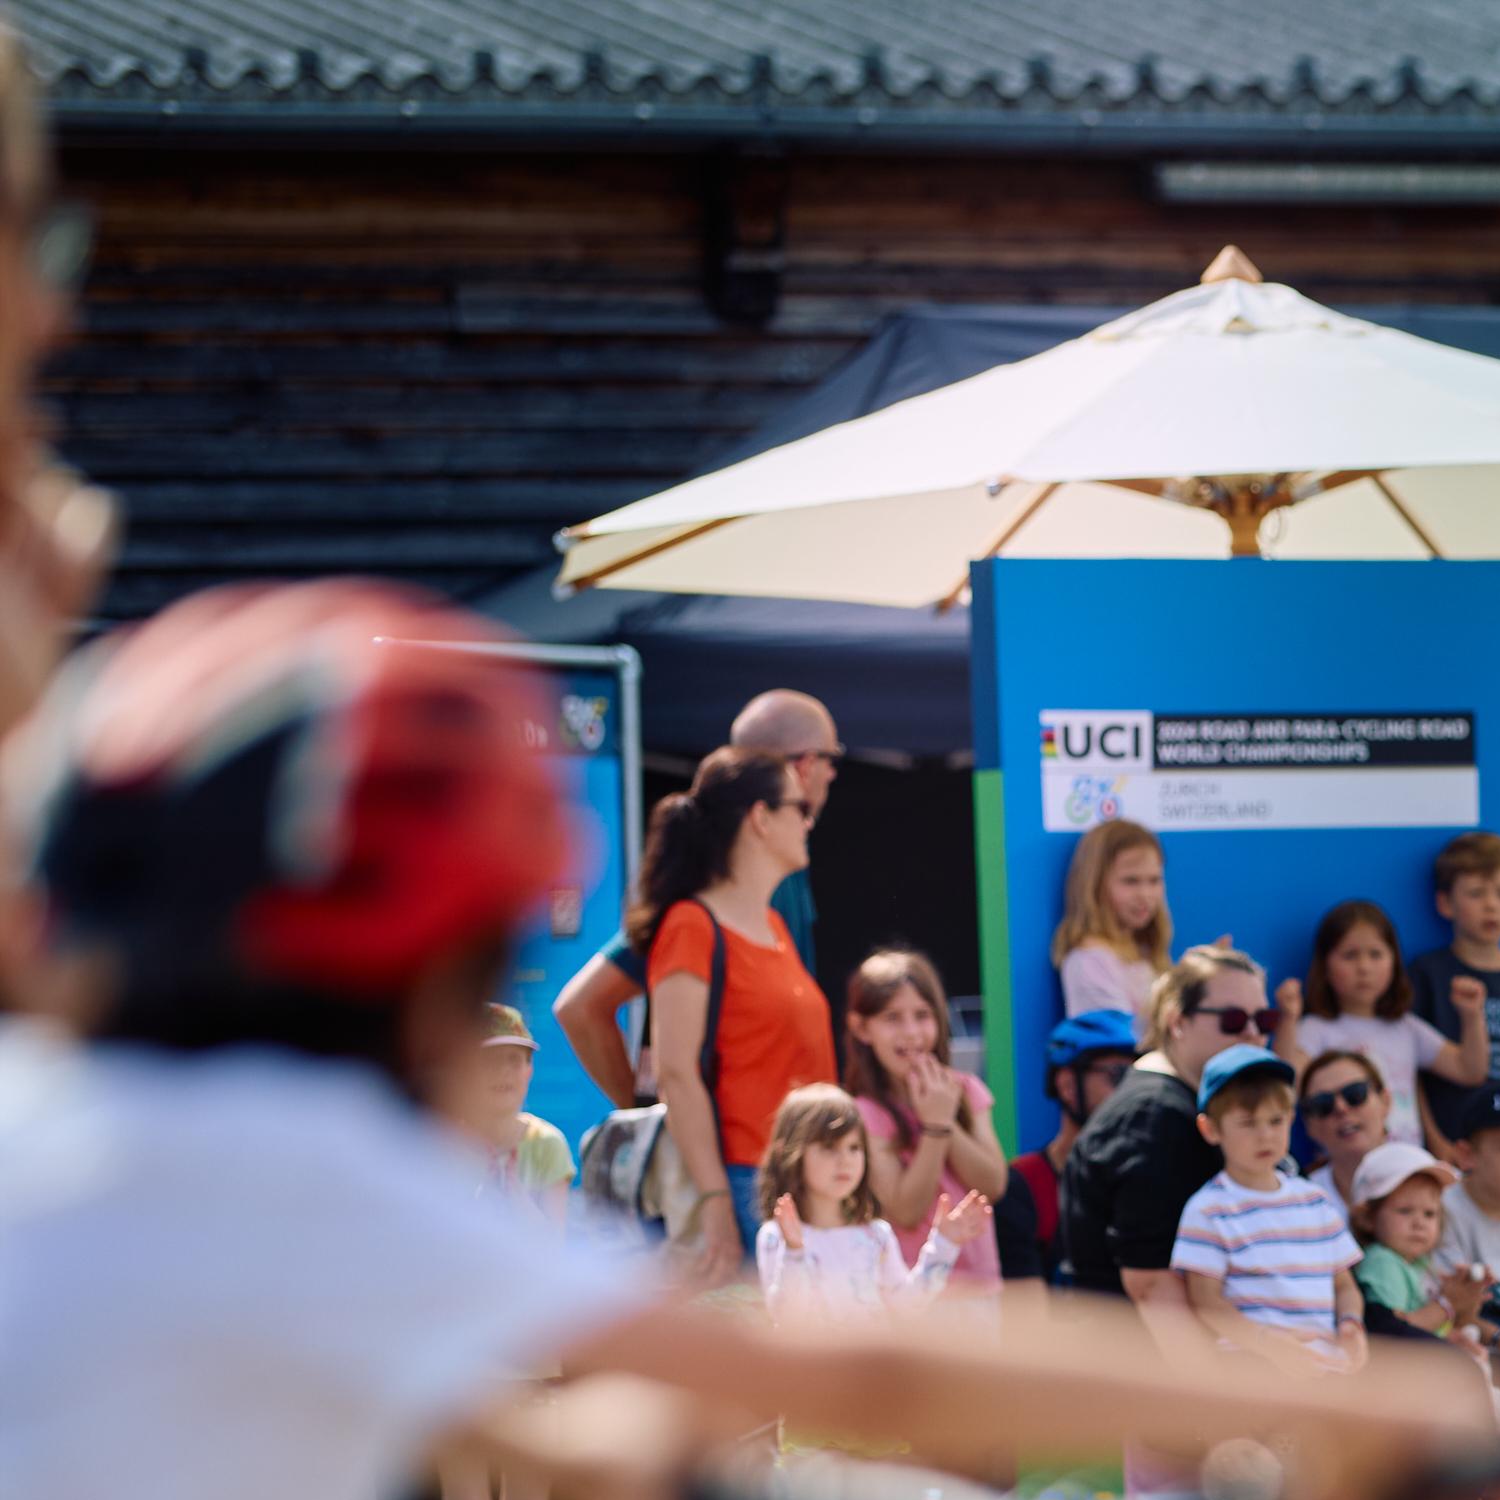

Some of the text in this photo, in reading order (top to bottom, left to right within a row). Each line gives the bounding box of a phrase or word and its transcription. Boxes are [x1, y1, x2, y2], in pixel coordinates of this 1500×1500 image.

[1199, 719, 1249, 741] ROAD
[1252, 719, 1290, 740] AND
[1419, 718, 1470, 740] ROAD
[1062, 723, 1142, 760] UCI
[1157, 740, 1370, 763] WORLD CHAMPIONSHIPS
[1158, 800, 1270, 820] SWITZERLAND
